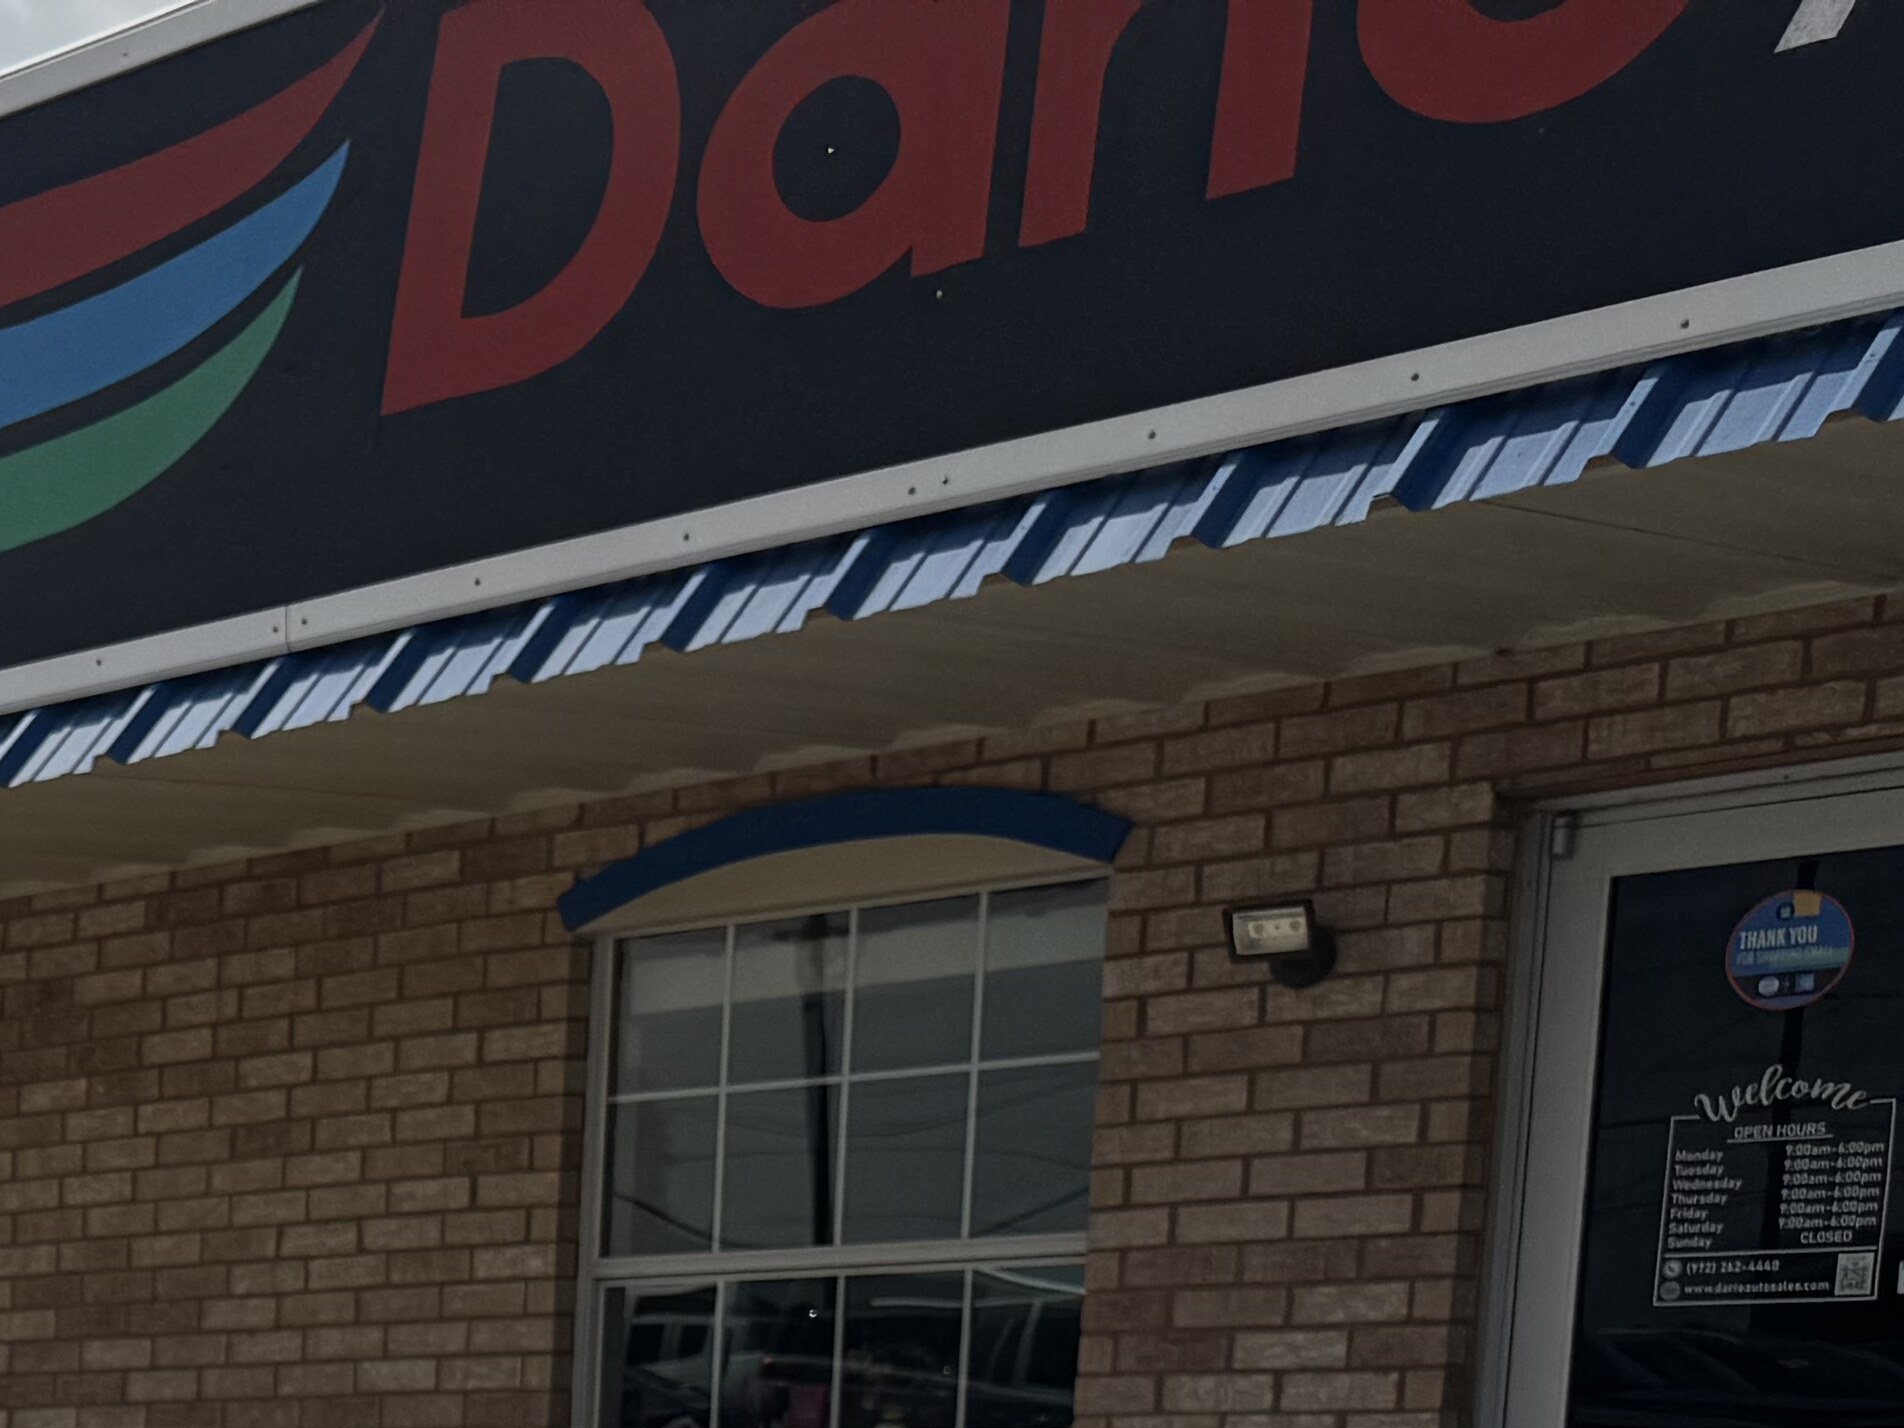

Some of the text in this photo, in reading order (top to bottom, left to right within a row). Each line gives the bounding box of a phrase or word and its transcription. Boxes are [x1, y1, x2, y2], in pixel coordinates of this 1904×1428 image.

[1739, 925, 1818, 950] THANK YOU
[1694, 1063, 1869, 1122] Welcome
[1734, 1122, 1826, 1139] OPEN HOURS
[1675, 1149, 1724, 1162] Monday
[1674, 1164, 1724, 1177] Tuesday
[1672, 1178, 1742, 1191] Wednesday
[1671, 1193, 1728, 1206] Thursday
[1670, 1207, 1708, 1221] Friday
[1668, 1222, 1724, 1235] Saturday
[1667, 1231, 1853, 1249] Sunday CLOSED
